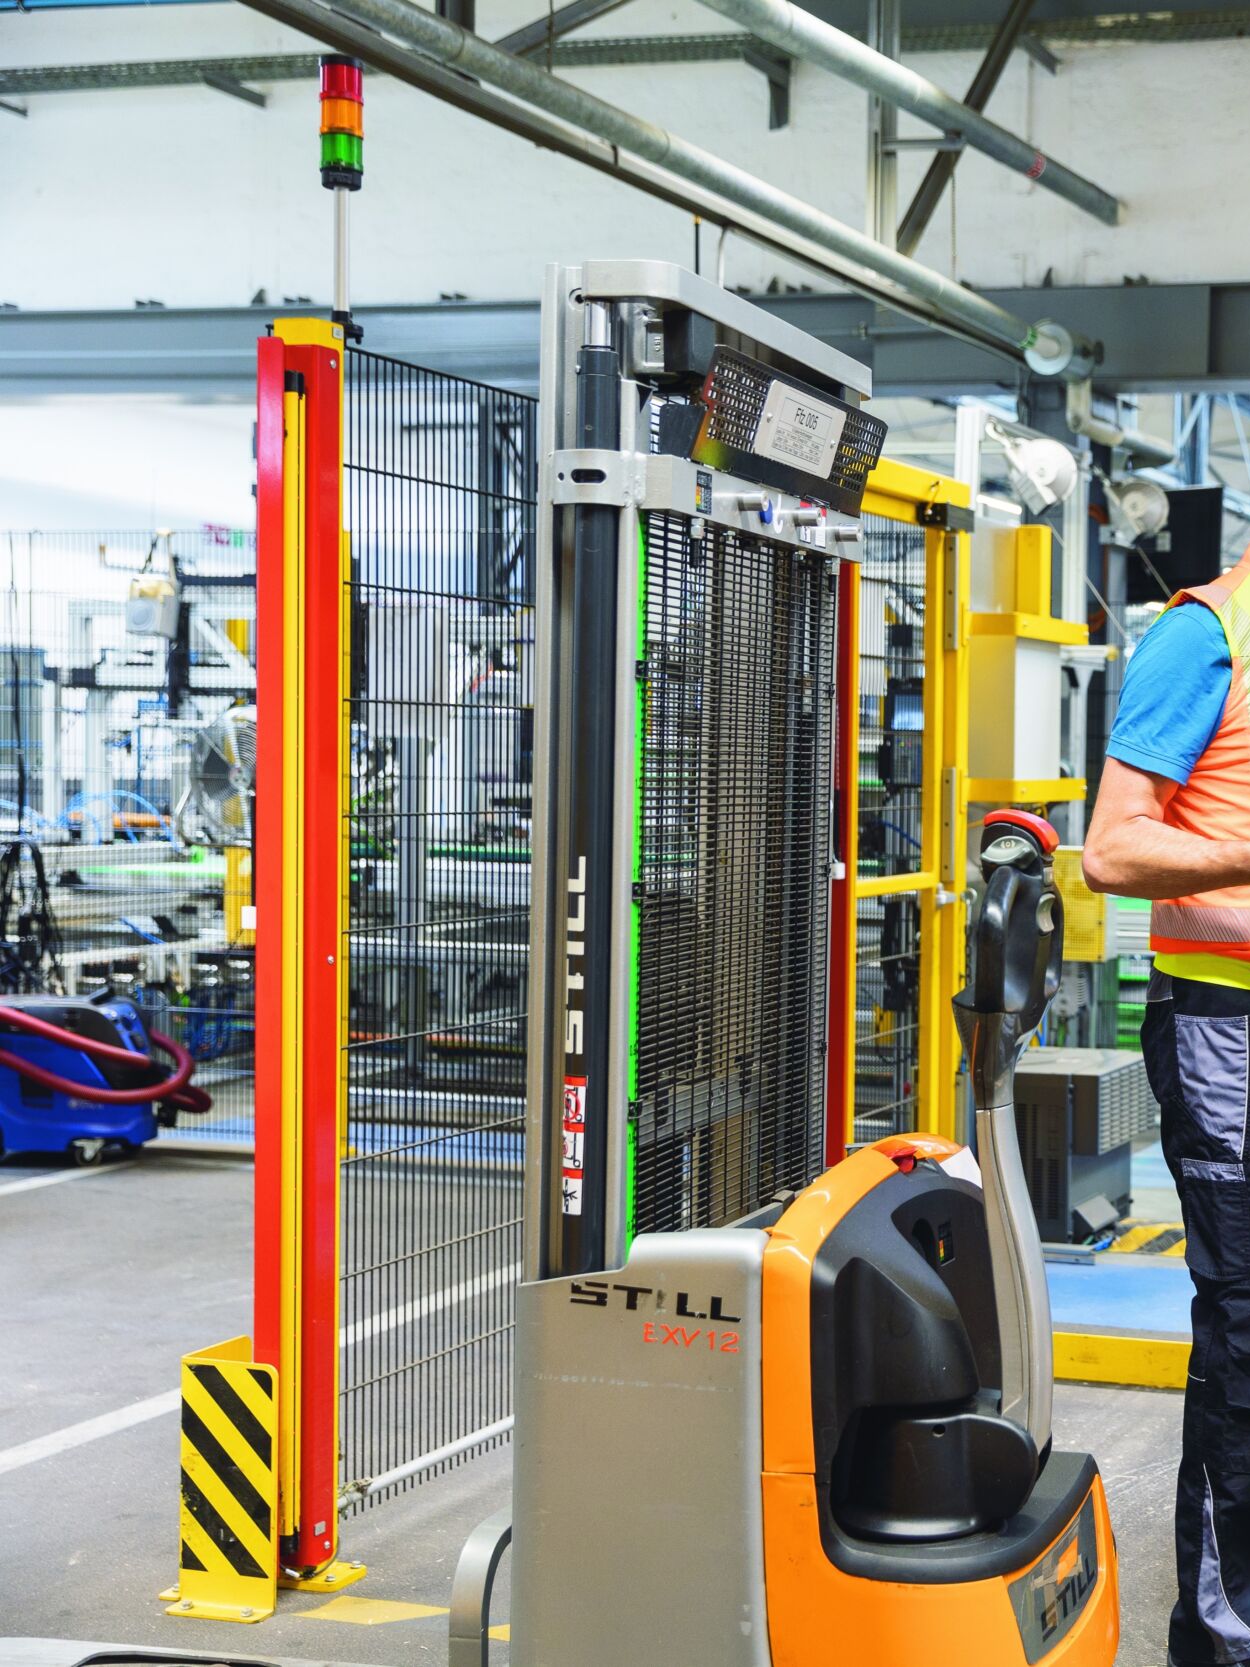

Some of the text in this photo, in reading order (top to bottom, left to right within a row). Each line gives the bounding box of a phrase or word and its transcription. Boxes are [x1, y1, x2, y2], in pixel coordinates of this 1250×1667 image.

[805, 412, 819, 430] 005
[565, 855, 587, 1055] STILL
[642, 1321, 740, 1353] EXV 12
[1041, 1557, 1095, 1643] STILL
